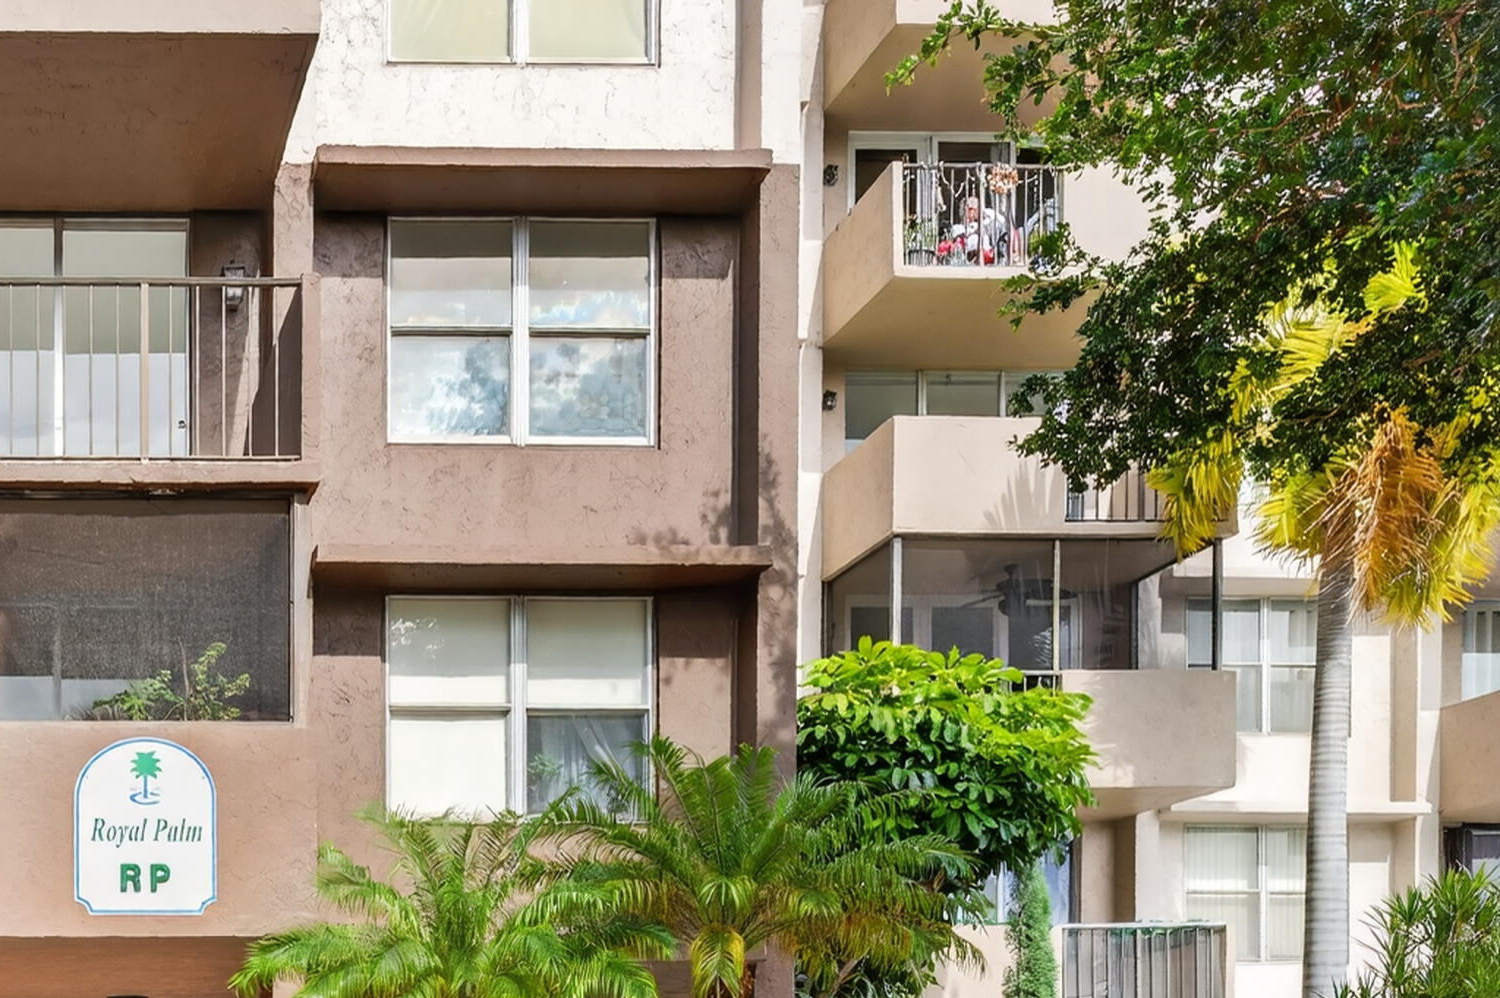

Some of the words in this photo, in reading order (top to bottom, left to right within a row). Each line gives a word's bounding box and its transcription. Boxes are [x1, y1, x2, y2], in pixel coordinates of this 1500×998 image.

[91, 818, 148, 848] Royal
[153, 818, 203, 842] Palm
[119, 863, 171, 893] RP
